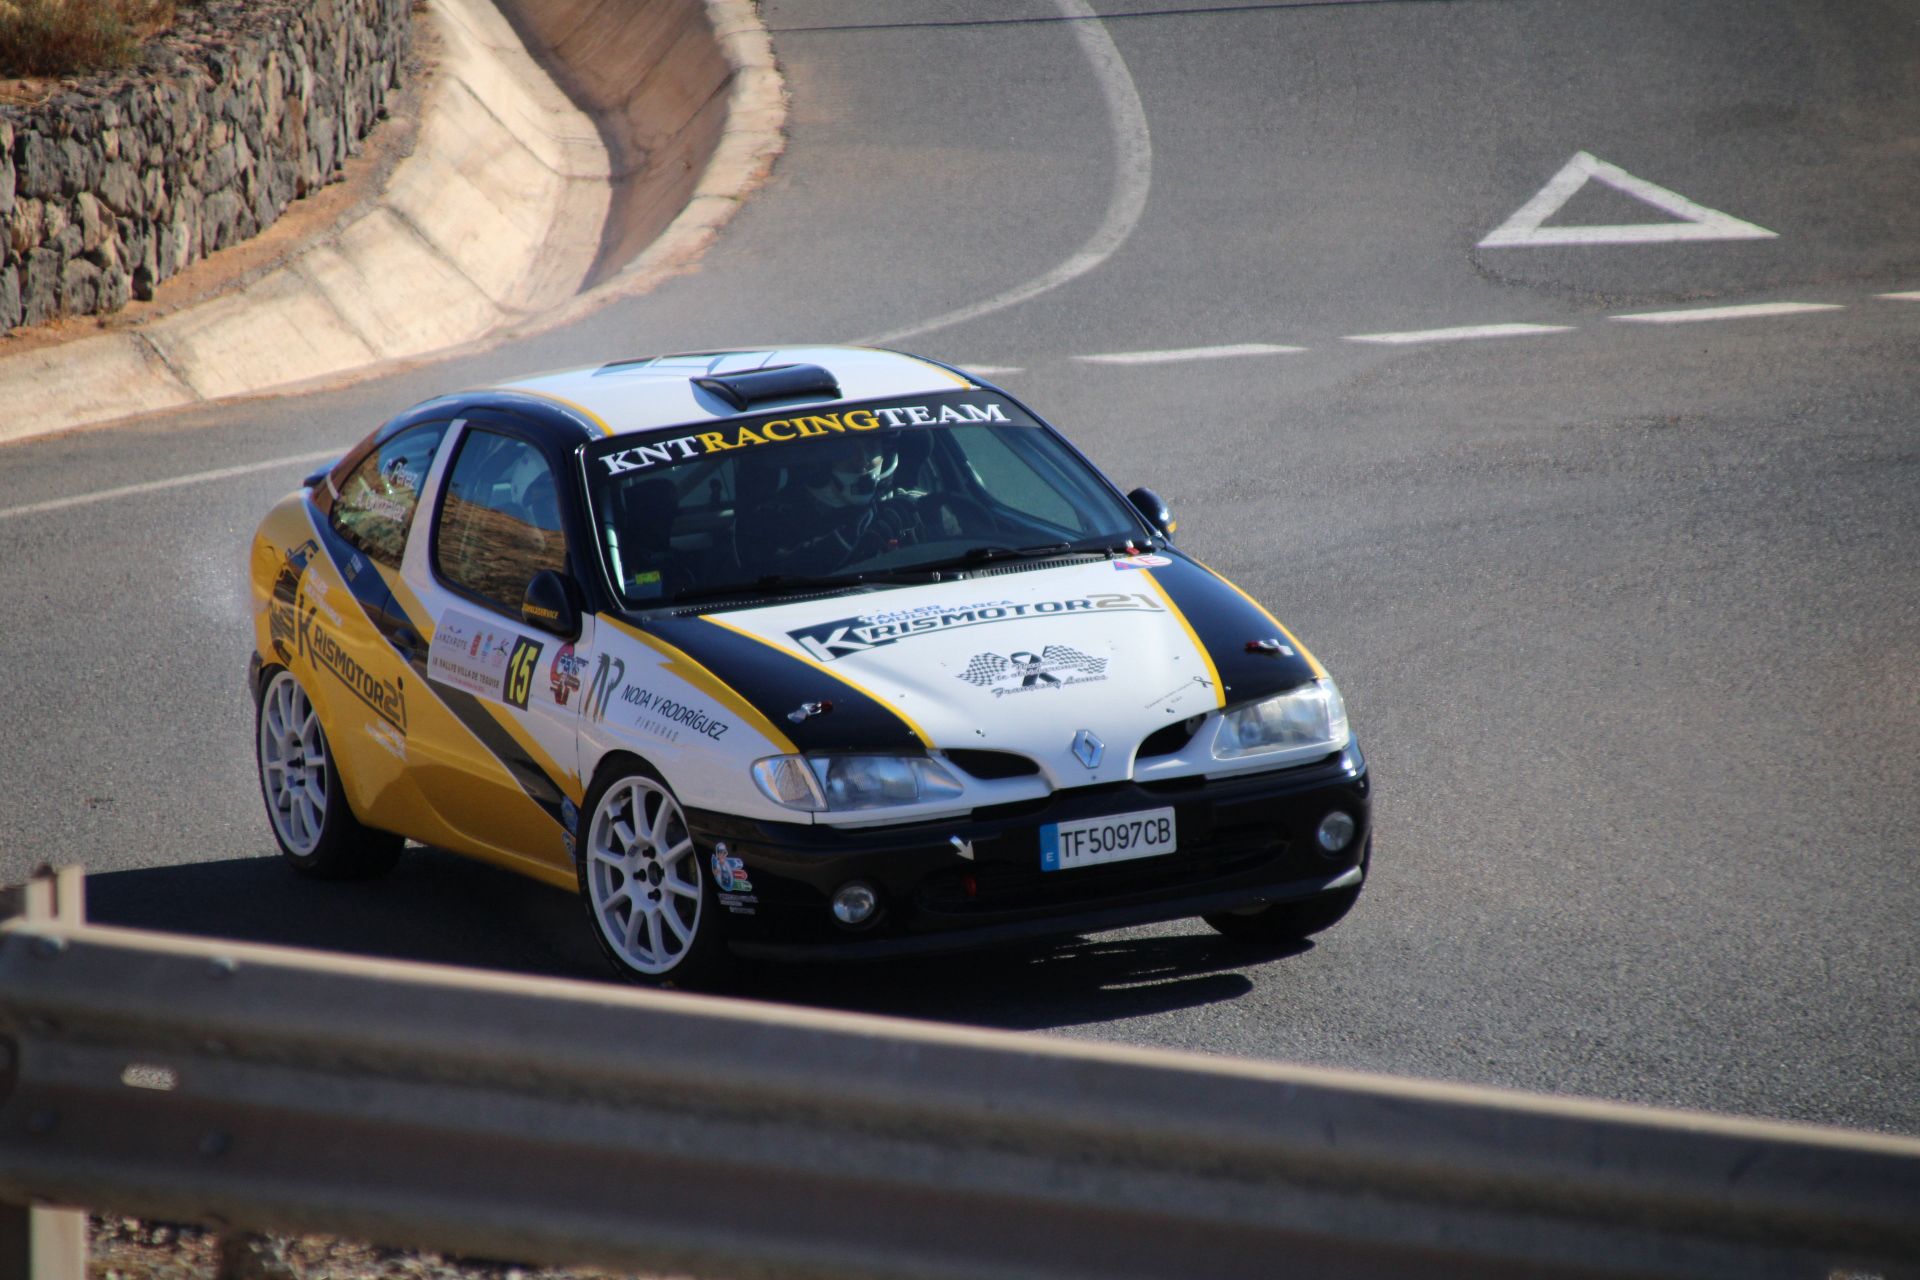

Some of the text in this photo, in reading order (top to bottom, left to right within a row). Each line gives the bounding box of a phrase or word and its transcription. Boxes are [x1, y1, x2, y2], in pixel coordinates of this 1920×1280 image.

[862, 605, 941, 622] TALLER
[509, 642, 538, 704] 15
[621, 684, 729, 740] NODA Y RODRÍGUEZ
[1046, 852, 1055, 862] E
